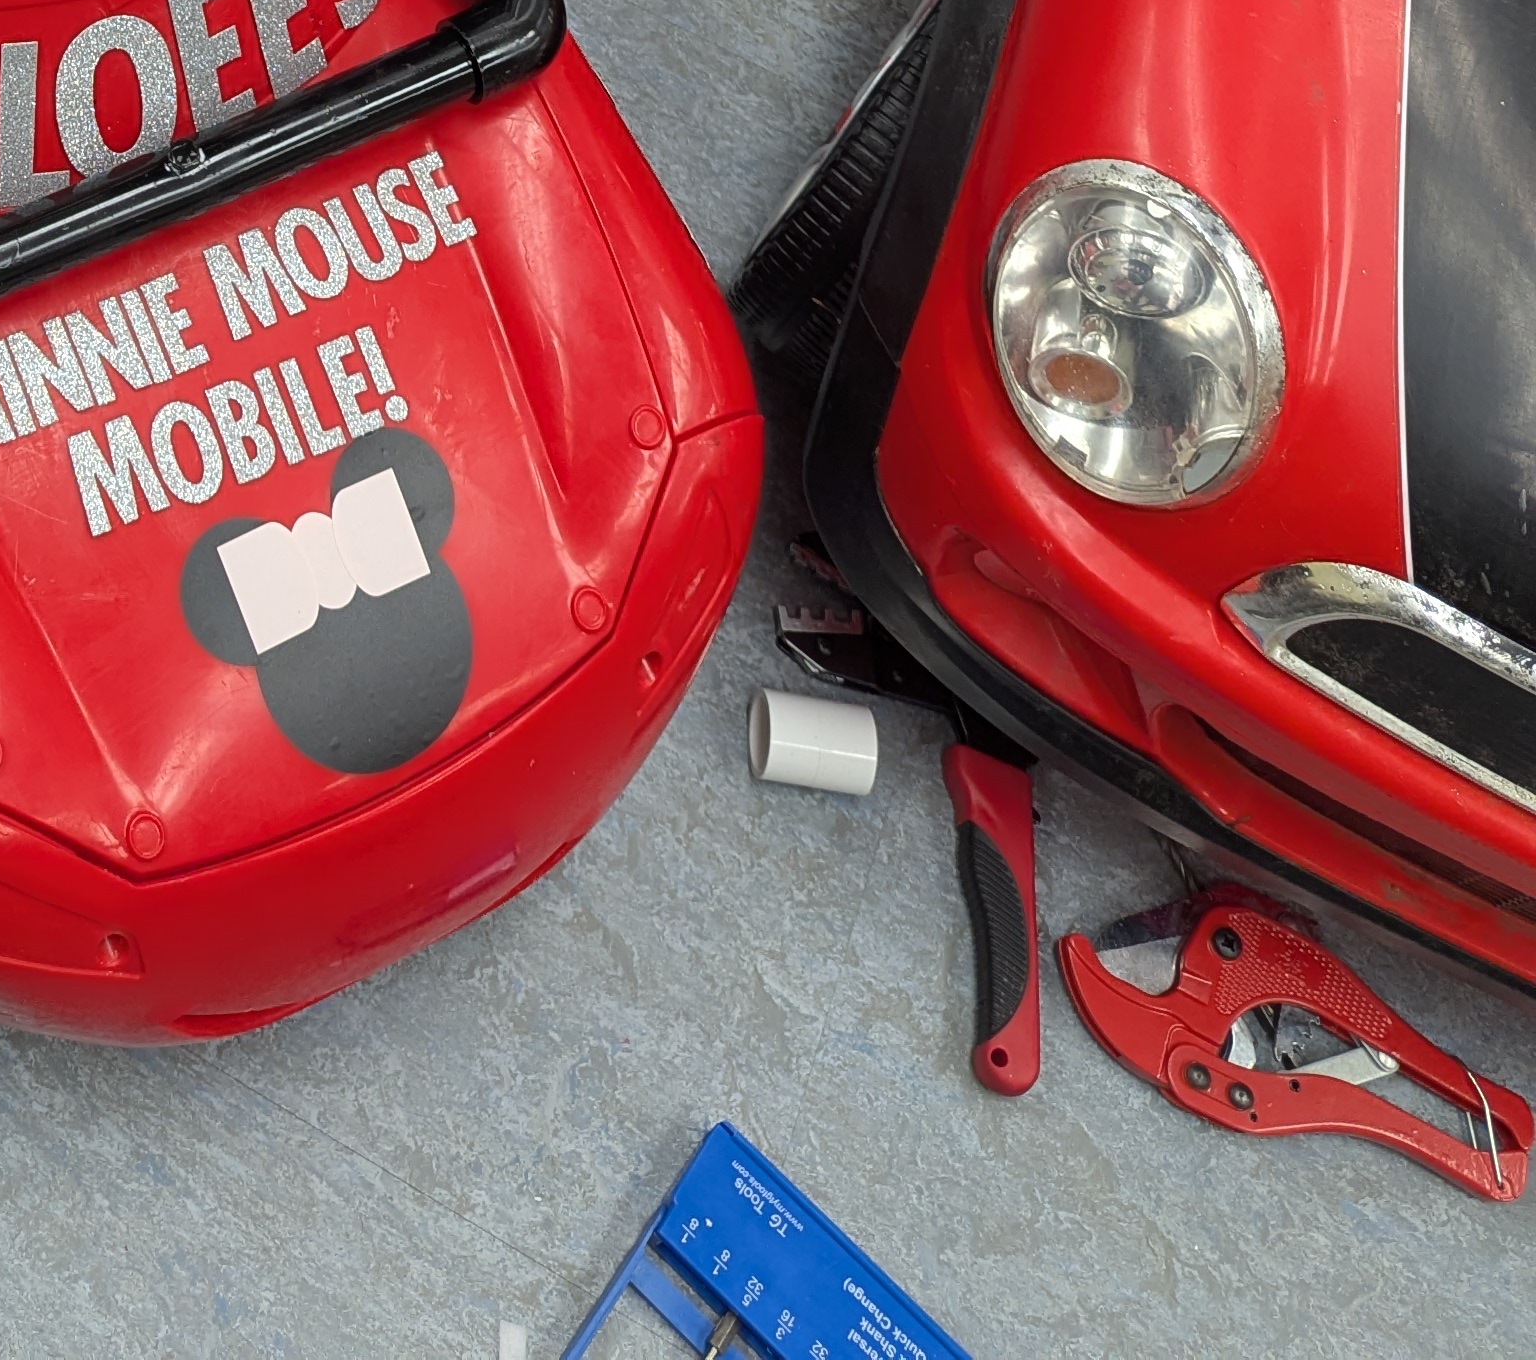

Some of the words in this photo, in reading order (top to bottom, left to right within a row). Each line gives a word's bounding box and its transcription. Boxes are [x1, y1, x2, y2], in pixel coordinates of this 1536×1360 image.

[201, 149, 477, 341] MOUSE
[66, 324, 411, 539] MOBILE!
[731, 1159, 804, 1232] www.mytgtools.com
[734, 1176, 765, 1216] Tools
[768, 1213, 788, 1238] TG
[842, 1277, 892, 1330] Change)
[859, 1316, 897, 1358] Shank
